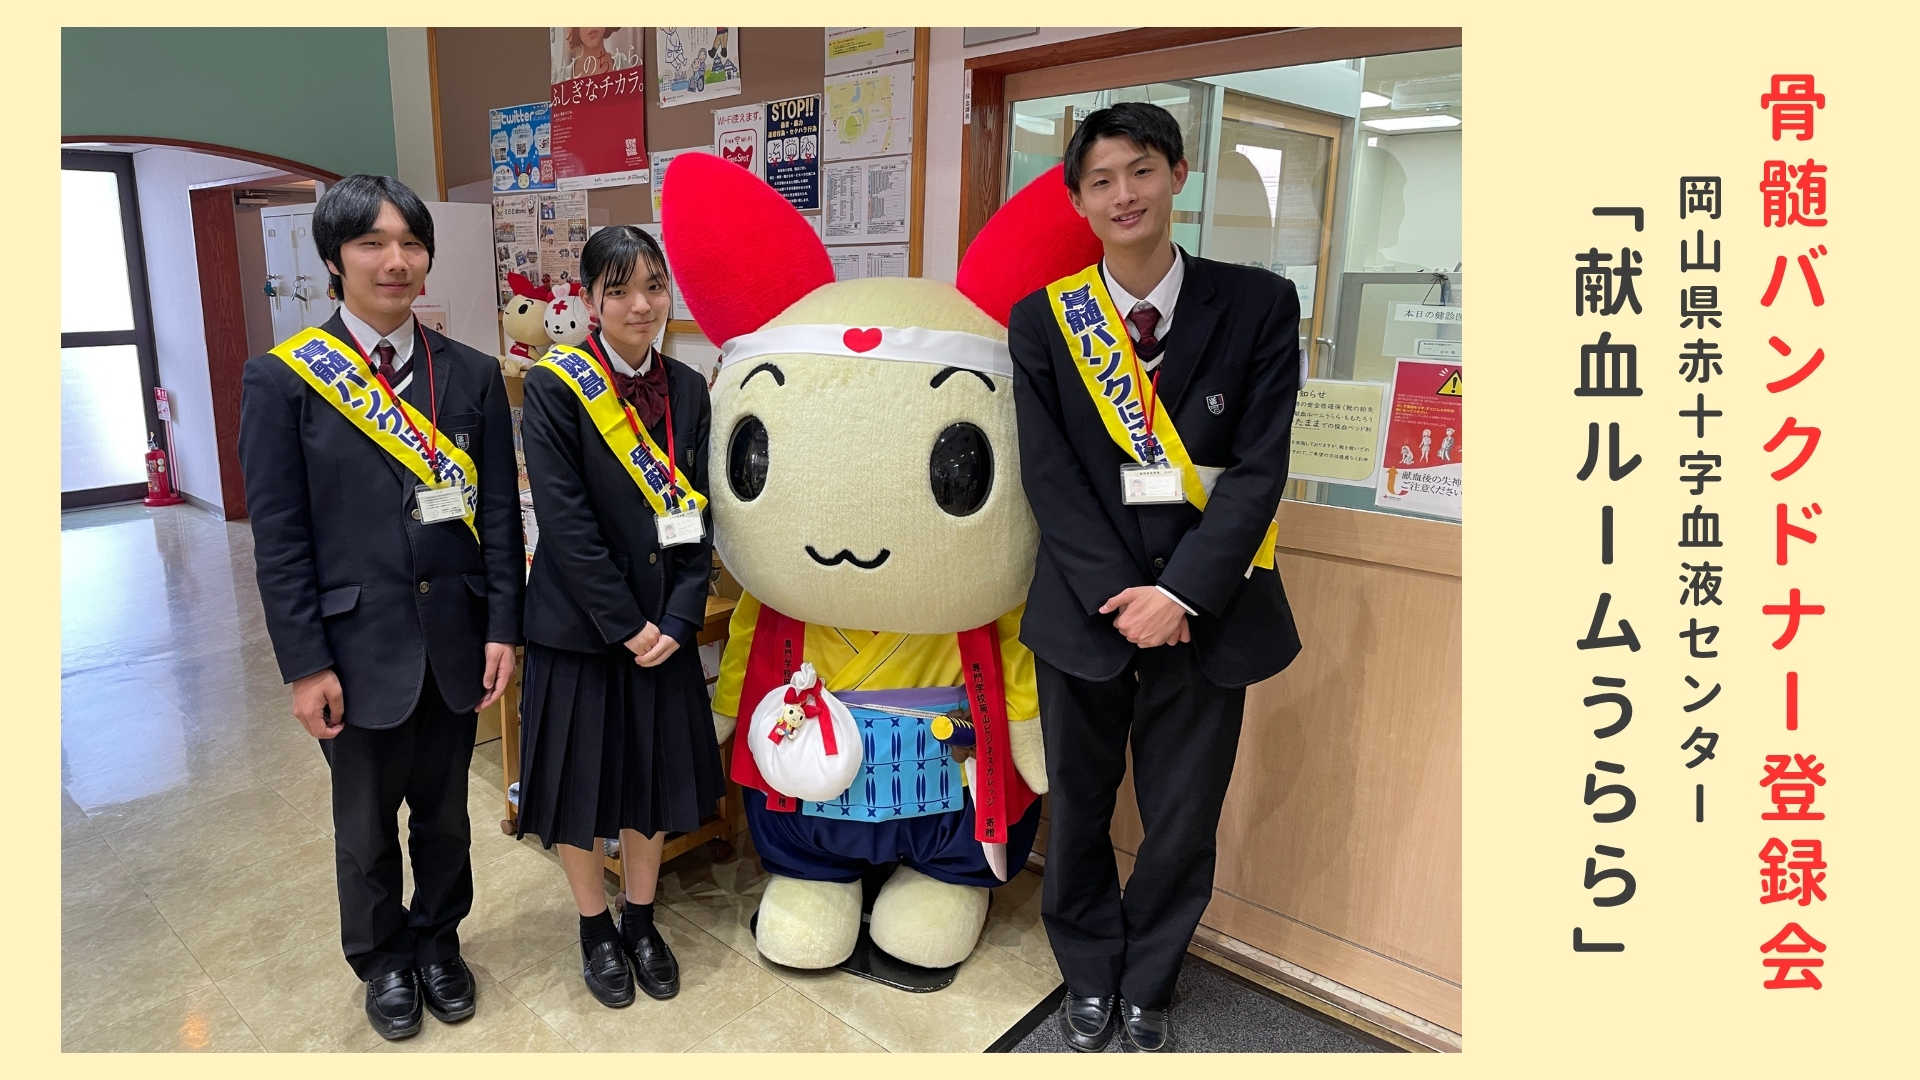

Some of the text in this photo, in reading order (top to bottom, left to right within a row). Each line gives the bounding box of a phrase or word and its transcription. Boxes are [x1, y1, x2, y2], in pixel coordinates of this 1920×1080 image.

[550, 71, 644, 107] ふしぎなチカラ。
[501, 109, 534, 125] twitter
[771, 97, 815, 122] STOP!!
[1292, 418, 1372, 433] たままでの採血ベッド利
[971, 662, 996, 838] 専門学校岡山ビジネスカレッジ 寄贈
